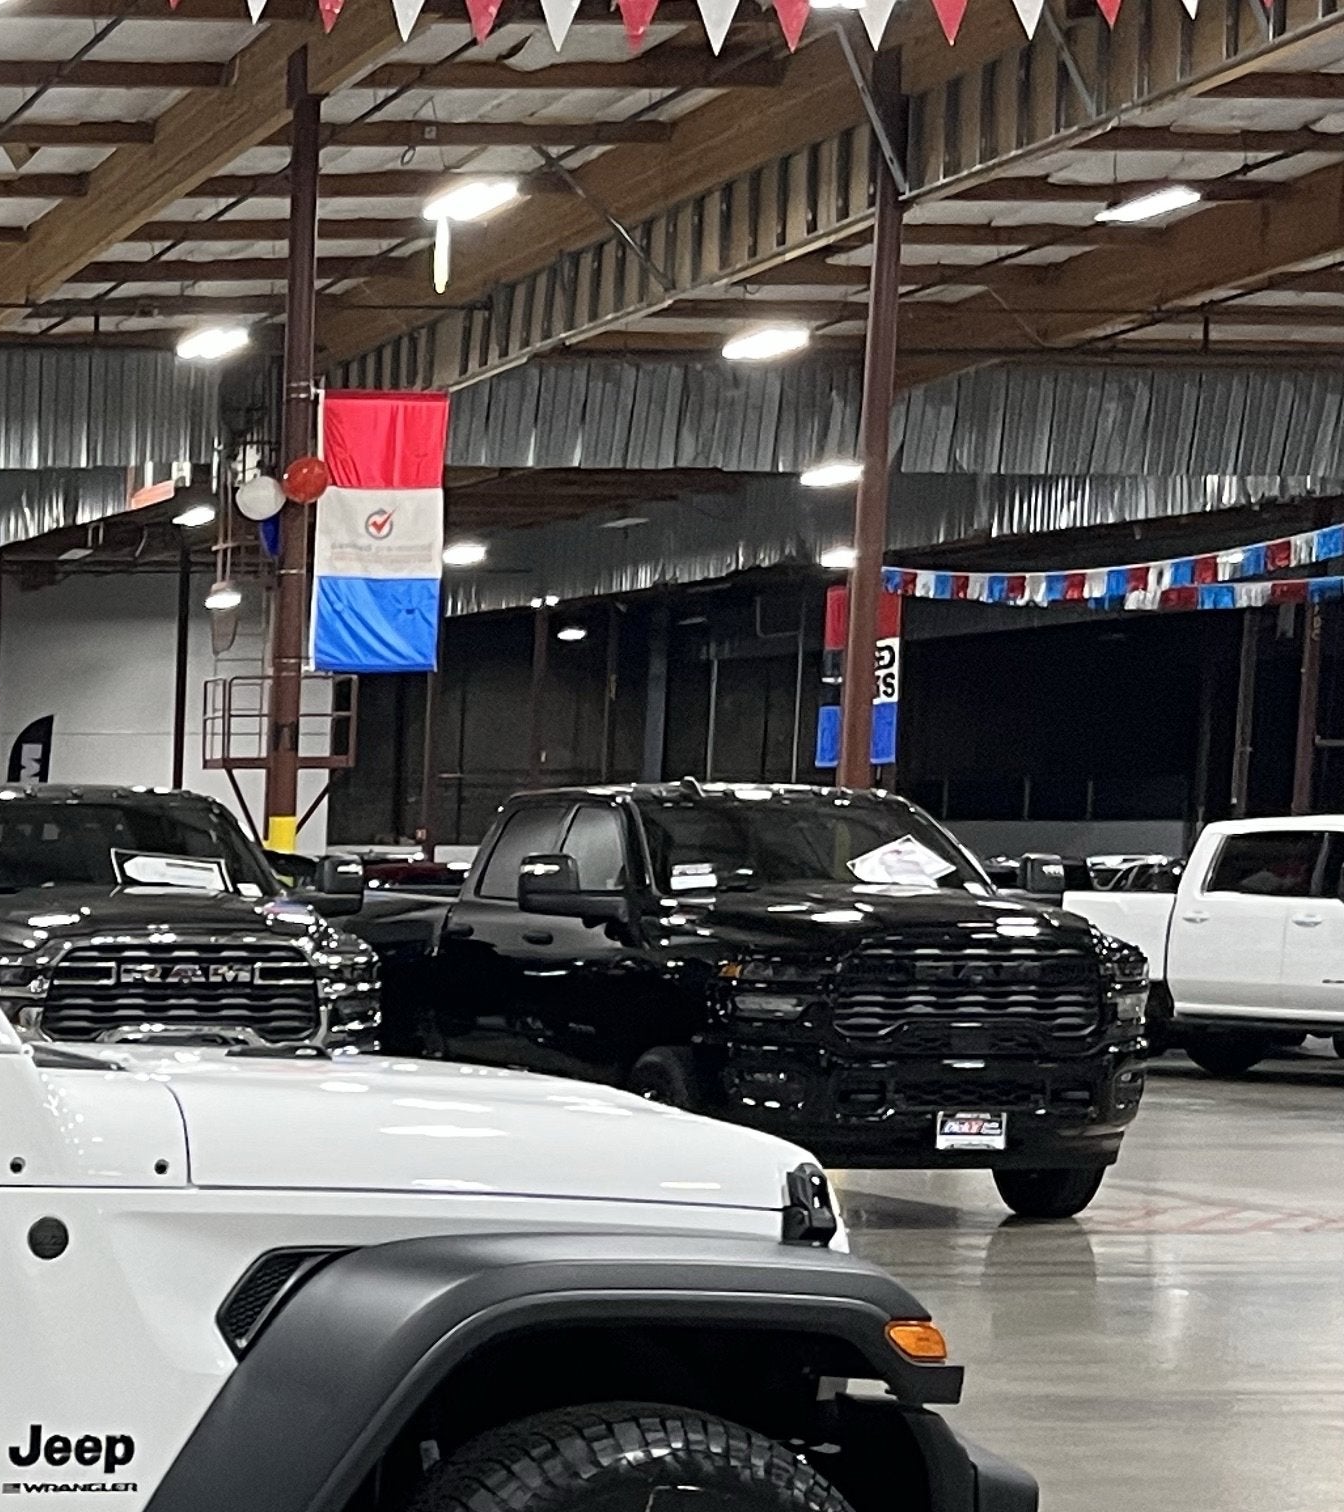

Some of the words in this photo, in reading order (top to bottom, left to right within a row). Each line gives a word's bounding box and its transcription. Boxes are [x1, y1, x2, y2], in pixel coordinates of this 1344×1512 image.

[120, 963, 253, 983] RAM
[8, 1424, 135, 1474] Jeep
[22, 1482, 138, 1493] WRANGLER
